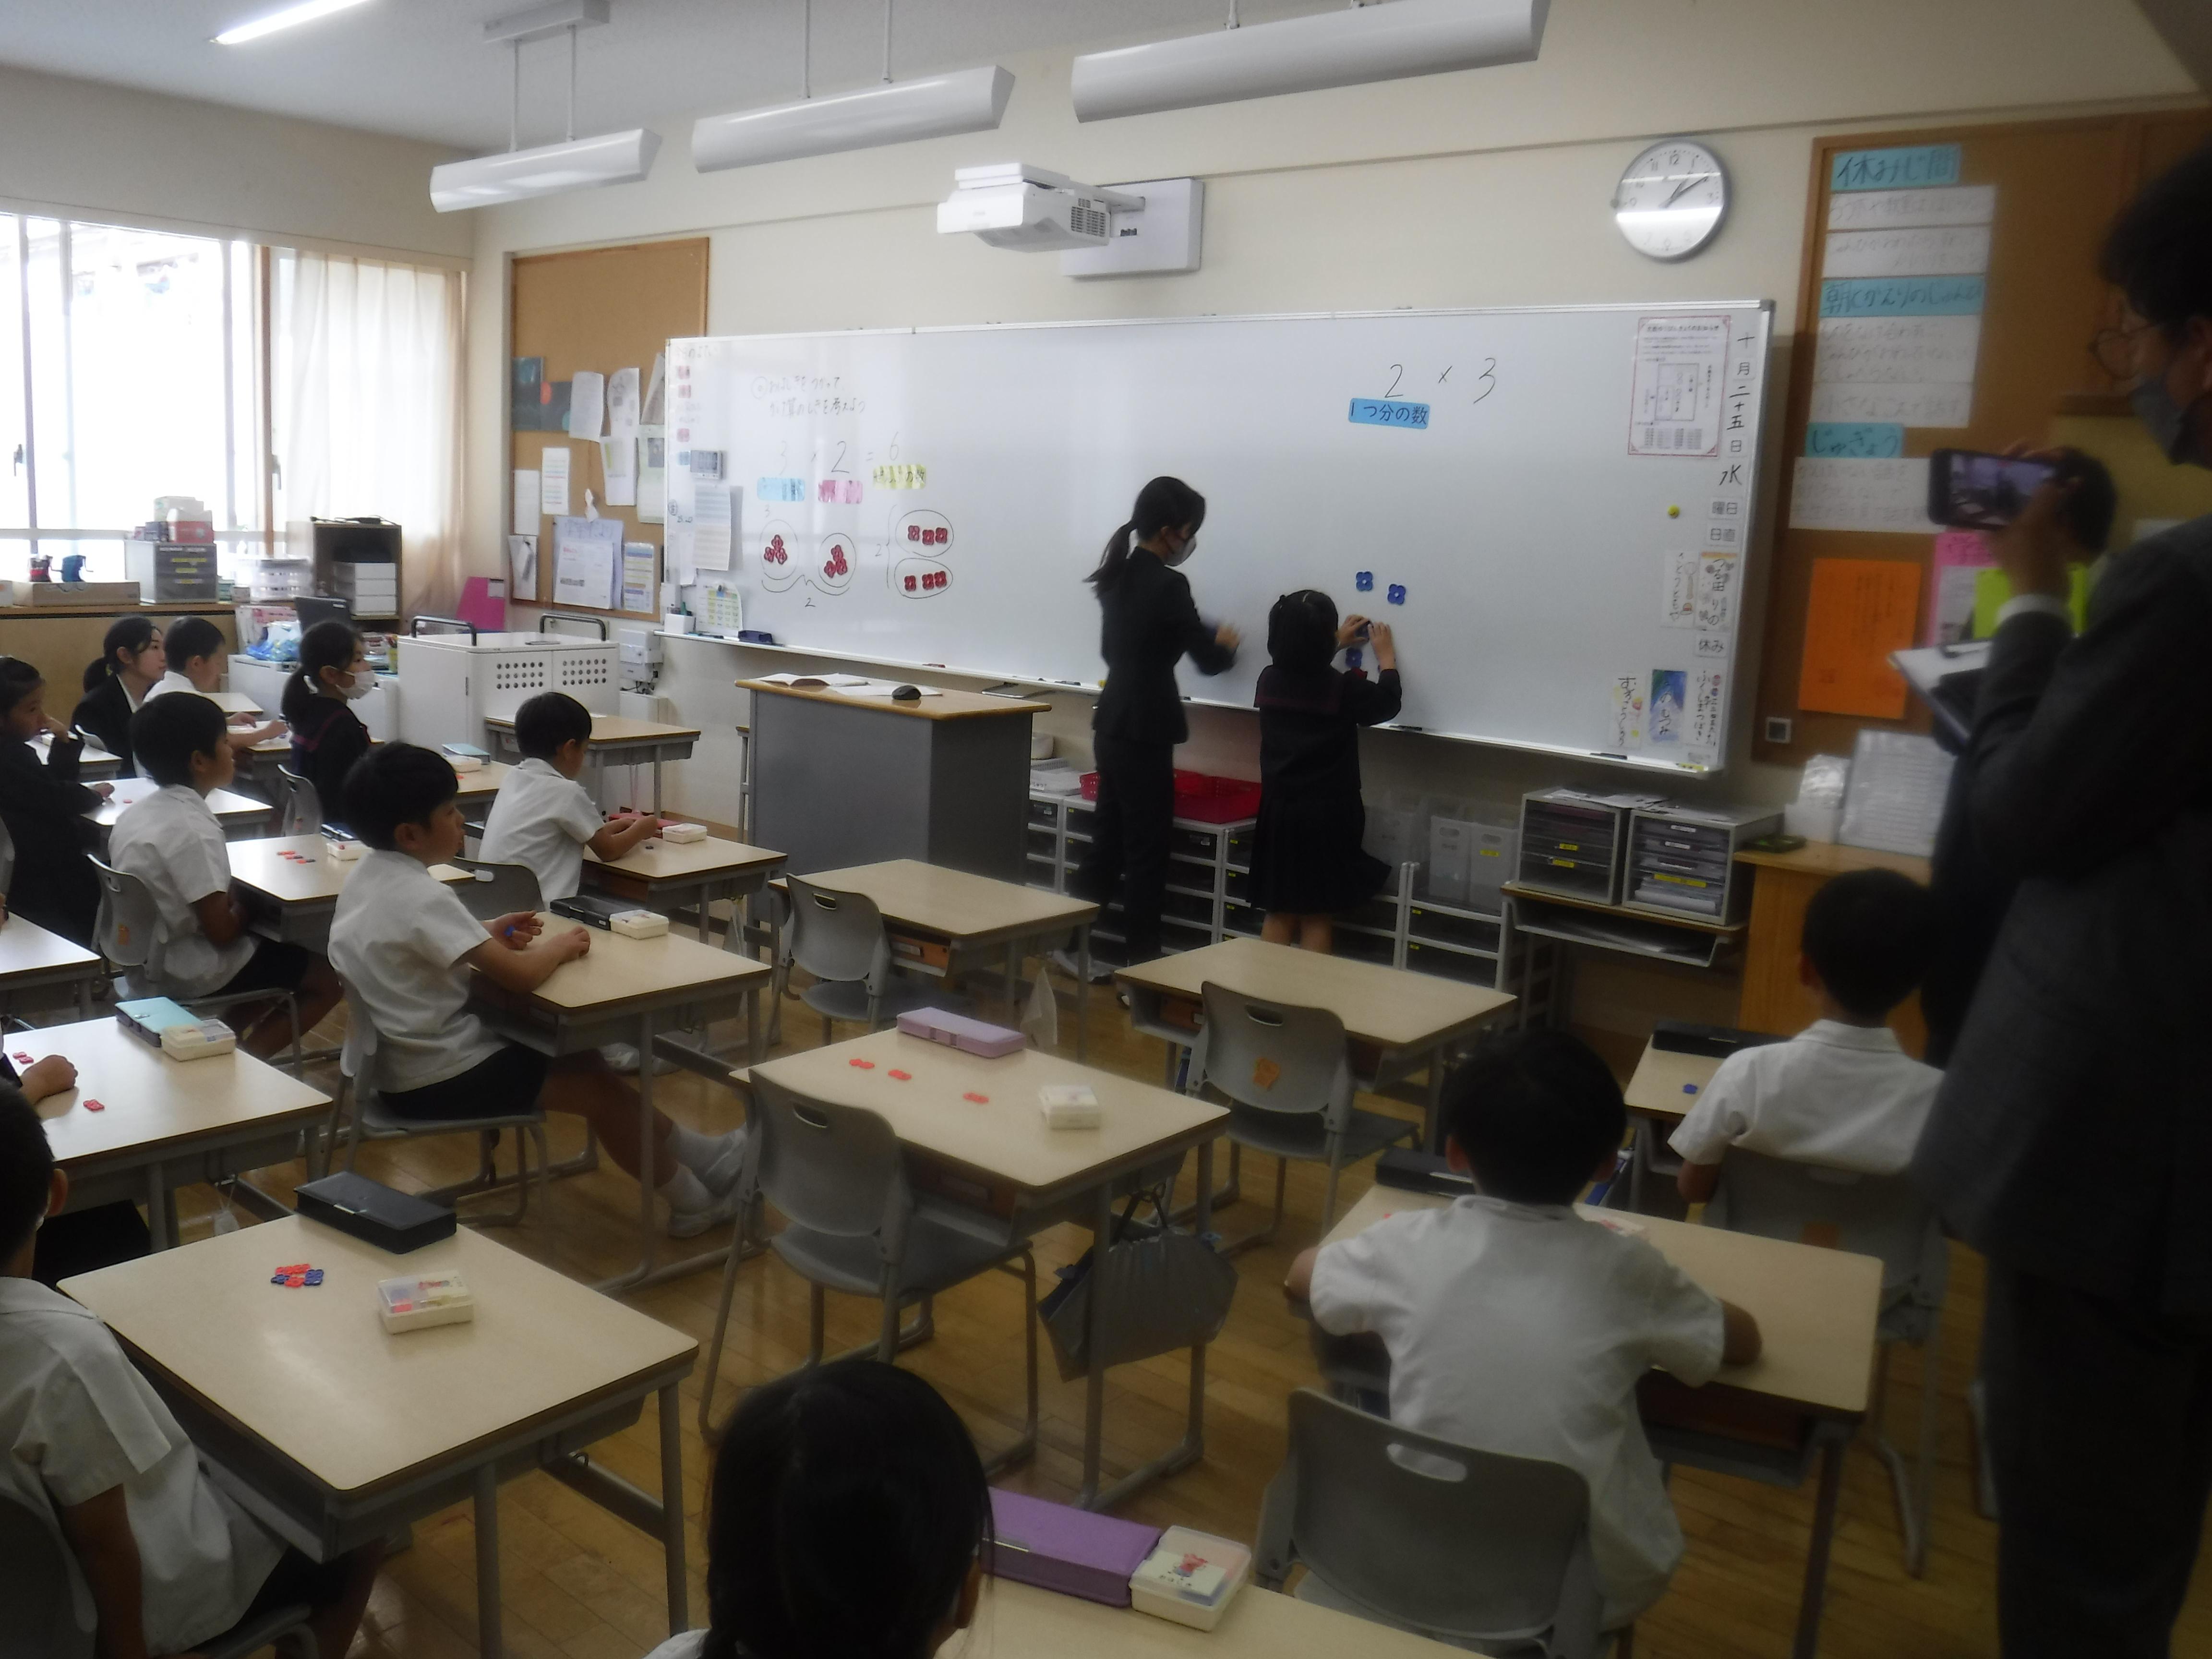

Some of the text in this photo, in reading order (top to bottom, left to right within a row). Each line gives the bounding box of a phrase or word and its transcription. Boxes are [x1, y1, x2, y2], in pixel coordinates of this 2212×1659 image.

[1651, 161, 1658, 172] 11
[1669, 154, 1680, 166] 12
[1707, 192, 1713, 204] 3
[1384, 363, 1404, 398] 2
[1473, 357, 1496, 404] 3
[779, 440, 787, 475] 3
[831, 441, 850, 473] 2
[890, 431, 899, 461] 6
[1712, 501, 1738, 515] 曜日
[1710, 528, 1736, 542] 日直
[875, 543, 882, 557] 2
[805, 598, 815, 608] 2
[1698, 638, 1724, 653] 休み
